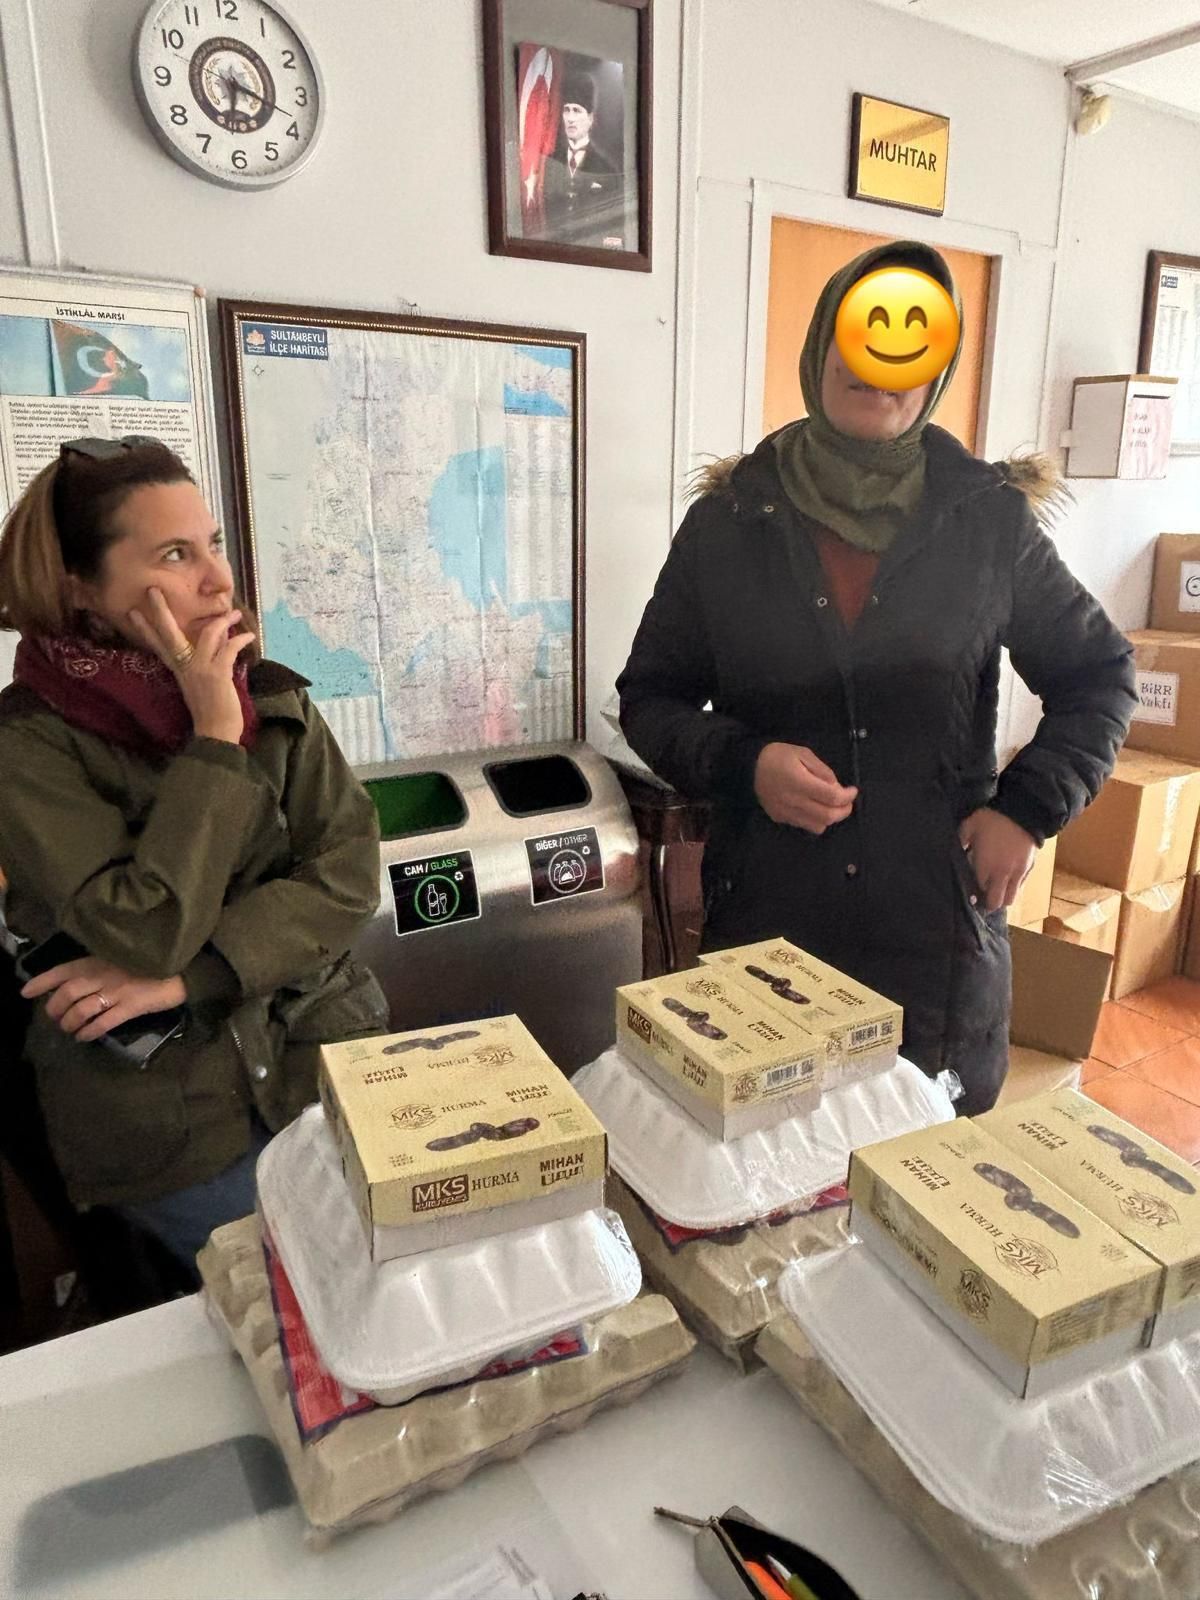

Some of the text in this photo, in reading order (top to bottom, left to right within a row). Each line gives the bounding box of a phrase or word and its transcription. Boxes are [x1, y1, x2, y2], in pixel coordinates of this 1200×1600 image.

[184, 5, 199, 26] 11
[216, 0, 239, 21] 12
[260, 17, 266, 38] 1
[161, 28, 184, 50] 10
[281, 50, 296, 70] 2
[153, 65, 172, 87] 9
[295, 86, 308, 107] 3
[169, 104, 188, 126] 8
[286, 120, 300, 141] 4
[195, 132, 212, 154] 7
[264, 141, 279, 161] 5
[231, 149, 248, 170] 6
[869, 138, 937, 172] MUHTAR
[270, 329, 325, 343] SULTANBEYLİ
[269, 341, 328, 357] İLÇE HARİTASI
[404, 864, 424, 877] CAM
[430, 857, 459, 871] GLASS
[755, 1020, 786, 1041] MIHAN
[364, 1071, 408, 1085] MIHAN
[505, 1083, 549, 1098] MIHAN
[391, 1099, 487, 1124] MKS HURMA
[1017, 1121, 1060, 1150] MIHAN
[539, 1153, 584, 1172] MIHAN
[900, 1159, 941, 1192] MIHAN
[415, 1176, 466, 1204] MKS
[471, 1170, 520, 1191] HURMA
[1125, 1193, 1170, 1228] MKS
[959, 1202, 1048, 1277] HURMA MKS
